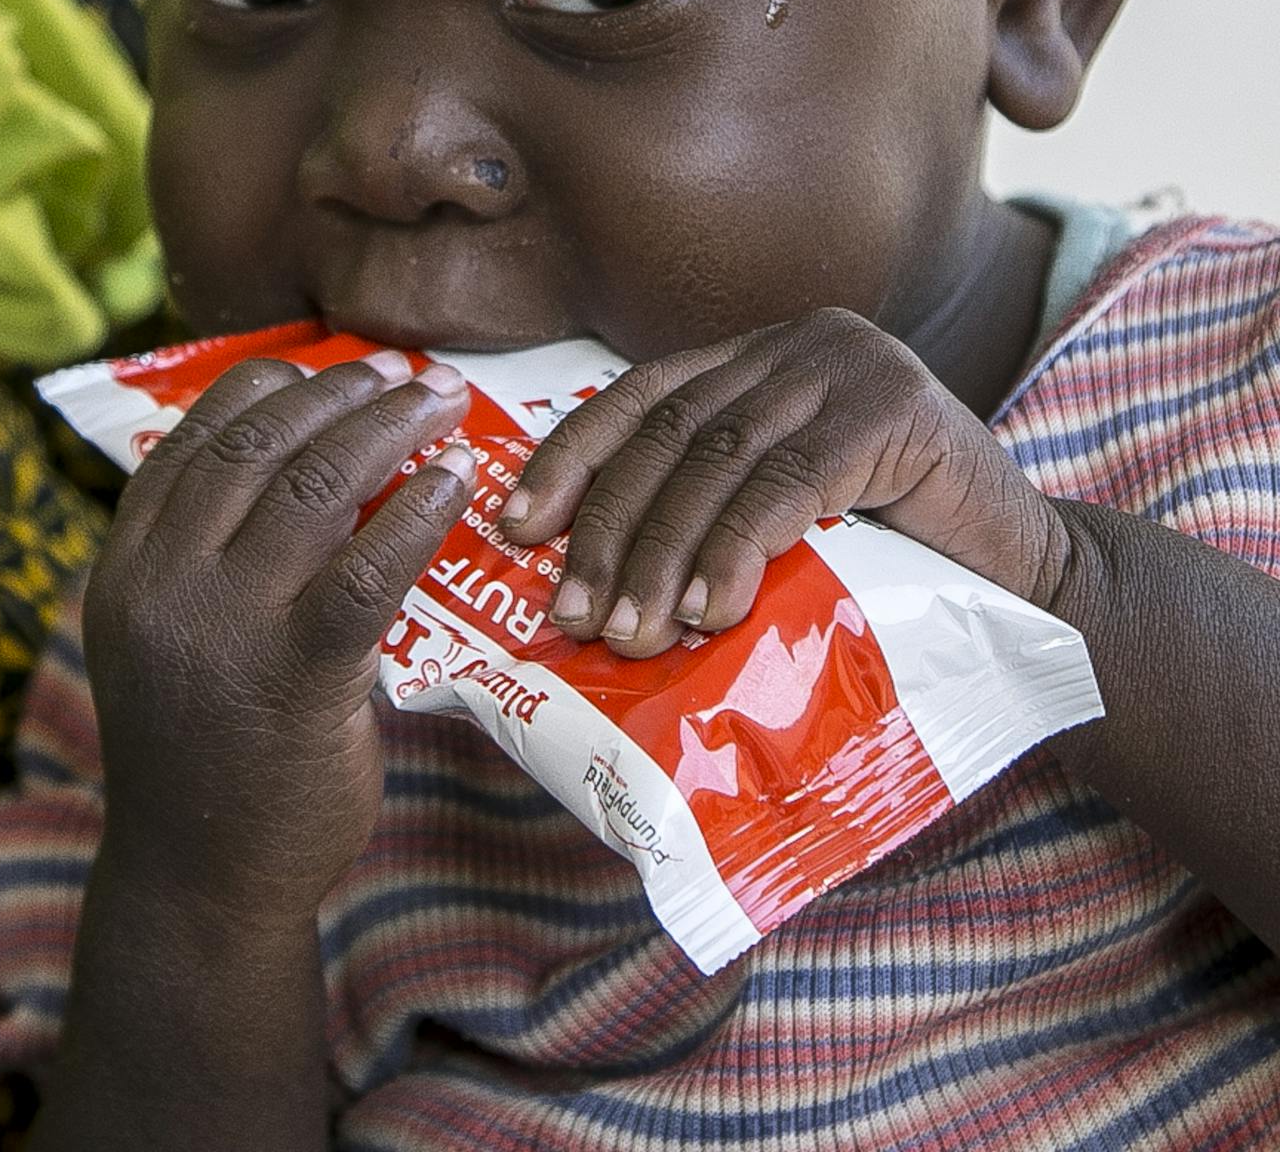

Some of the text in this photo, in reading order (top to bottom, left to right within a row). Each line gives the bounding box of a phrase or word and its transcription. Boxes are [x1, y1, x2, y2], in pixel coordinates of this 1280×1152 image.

[427, 557, 546, 645] RUTF
[537, 558, 563, 584] se
[582, 765, 670, 865] PlumpyField
